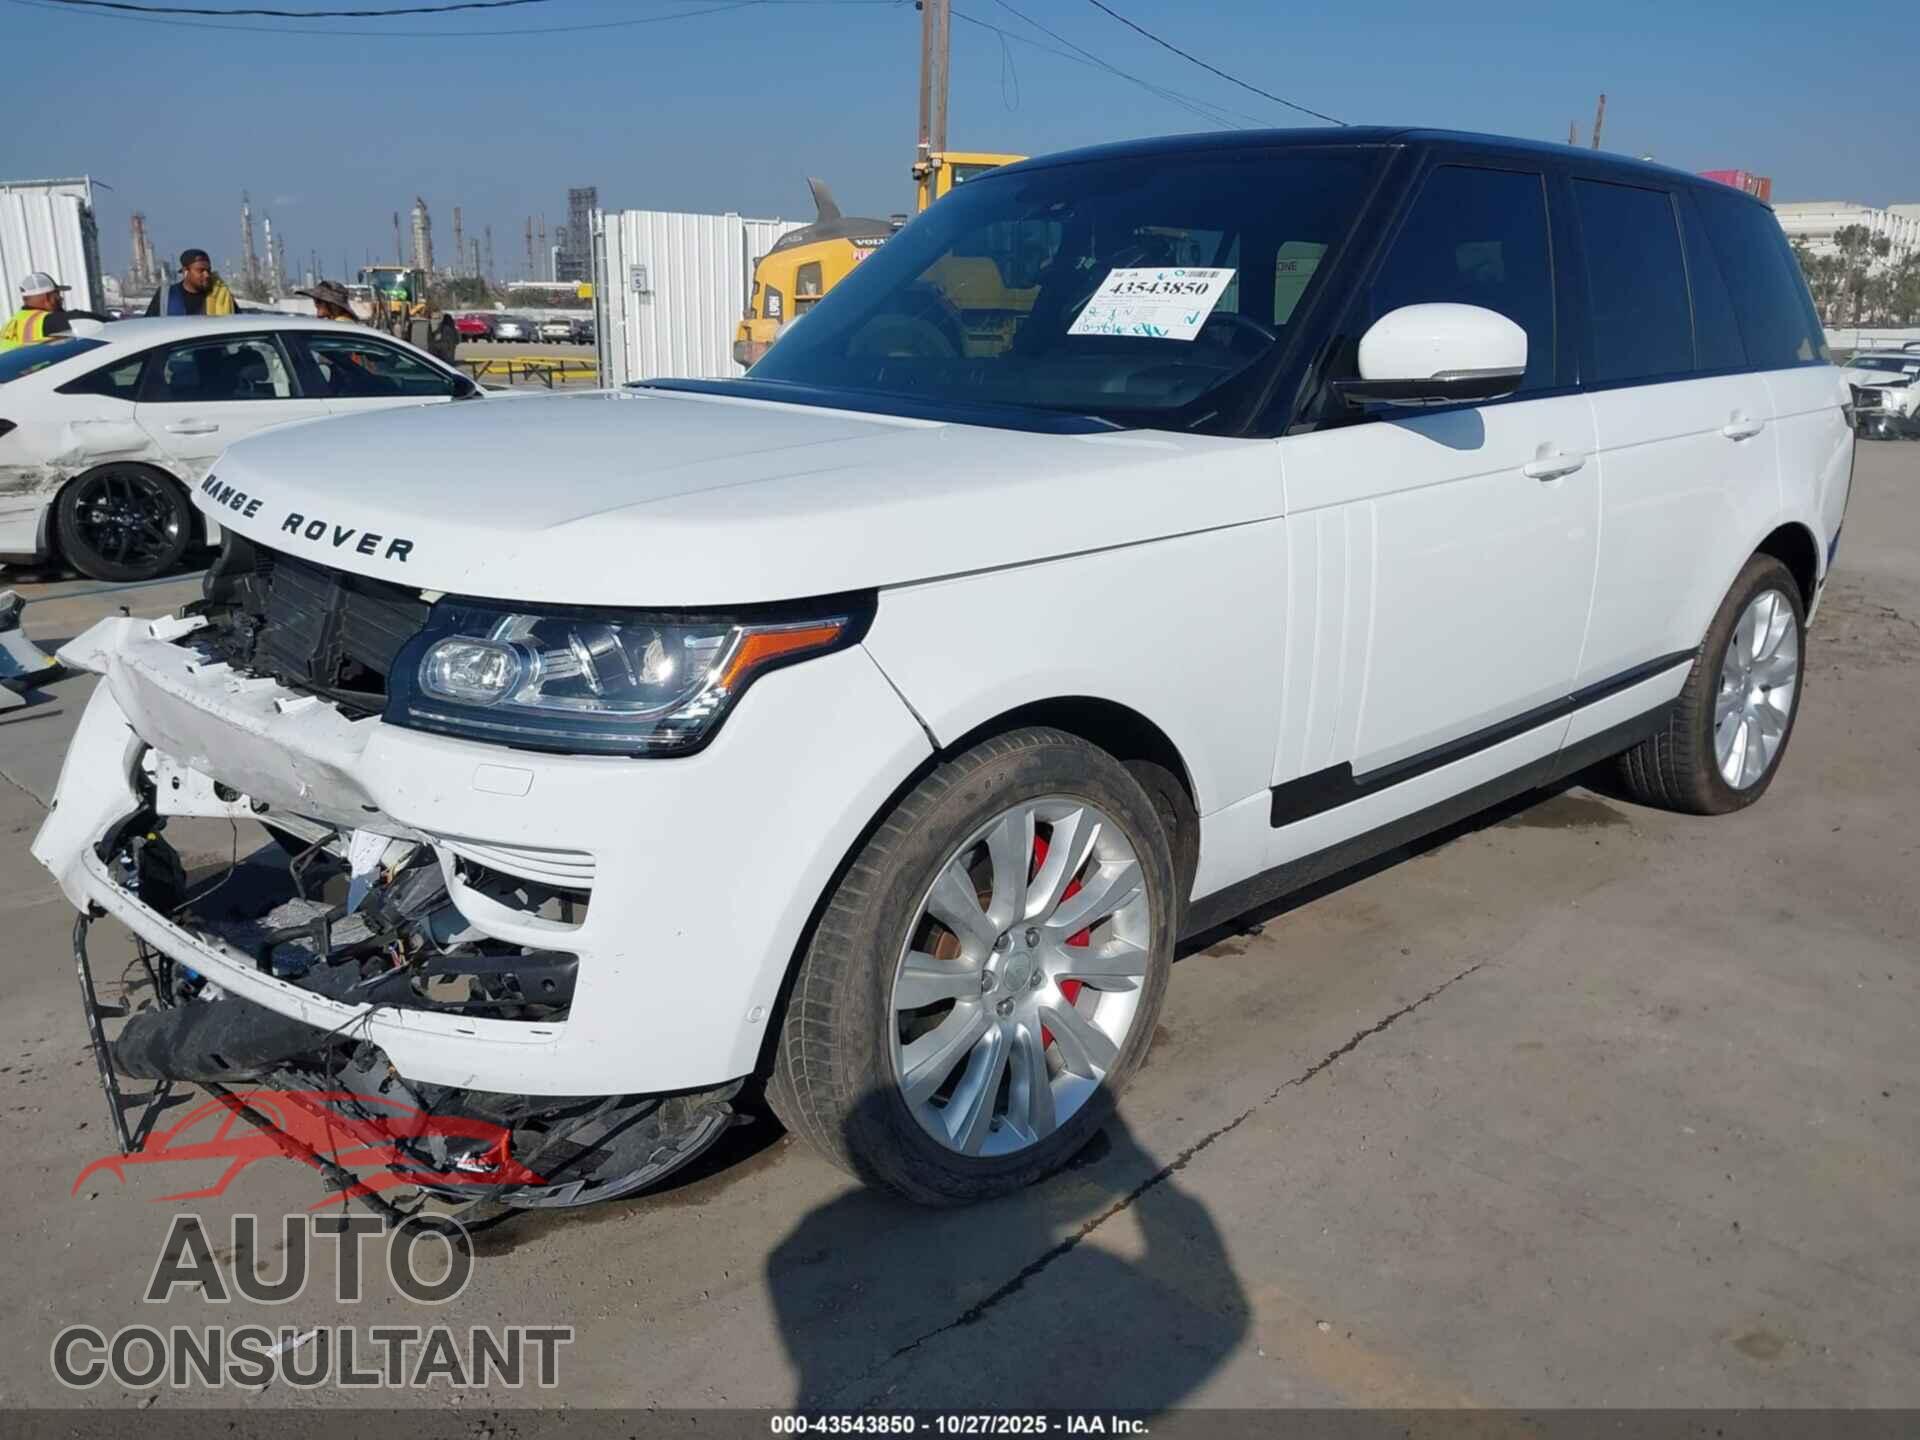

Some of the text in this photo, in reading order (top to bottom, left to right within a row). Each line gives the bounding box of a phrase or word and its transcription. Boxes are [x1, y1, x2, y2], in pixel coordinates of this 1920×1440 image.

[1109, 281, 1210, 296] 43543850
[201, 474, 413, 562] RANGE ROVER
